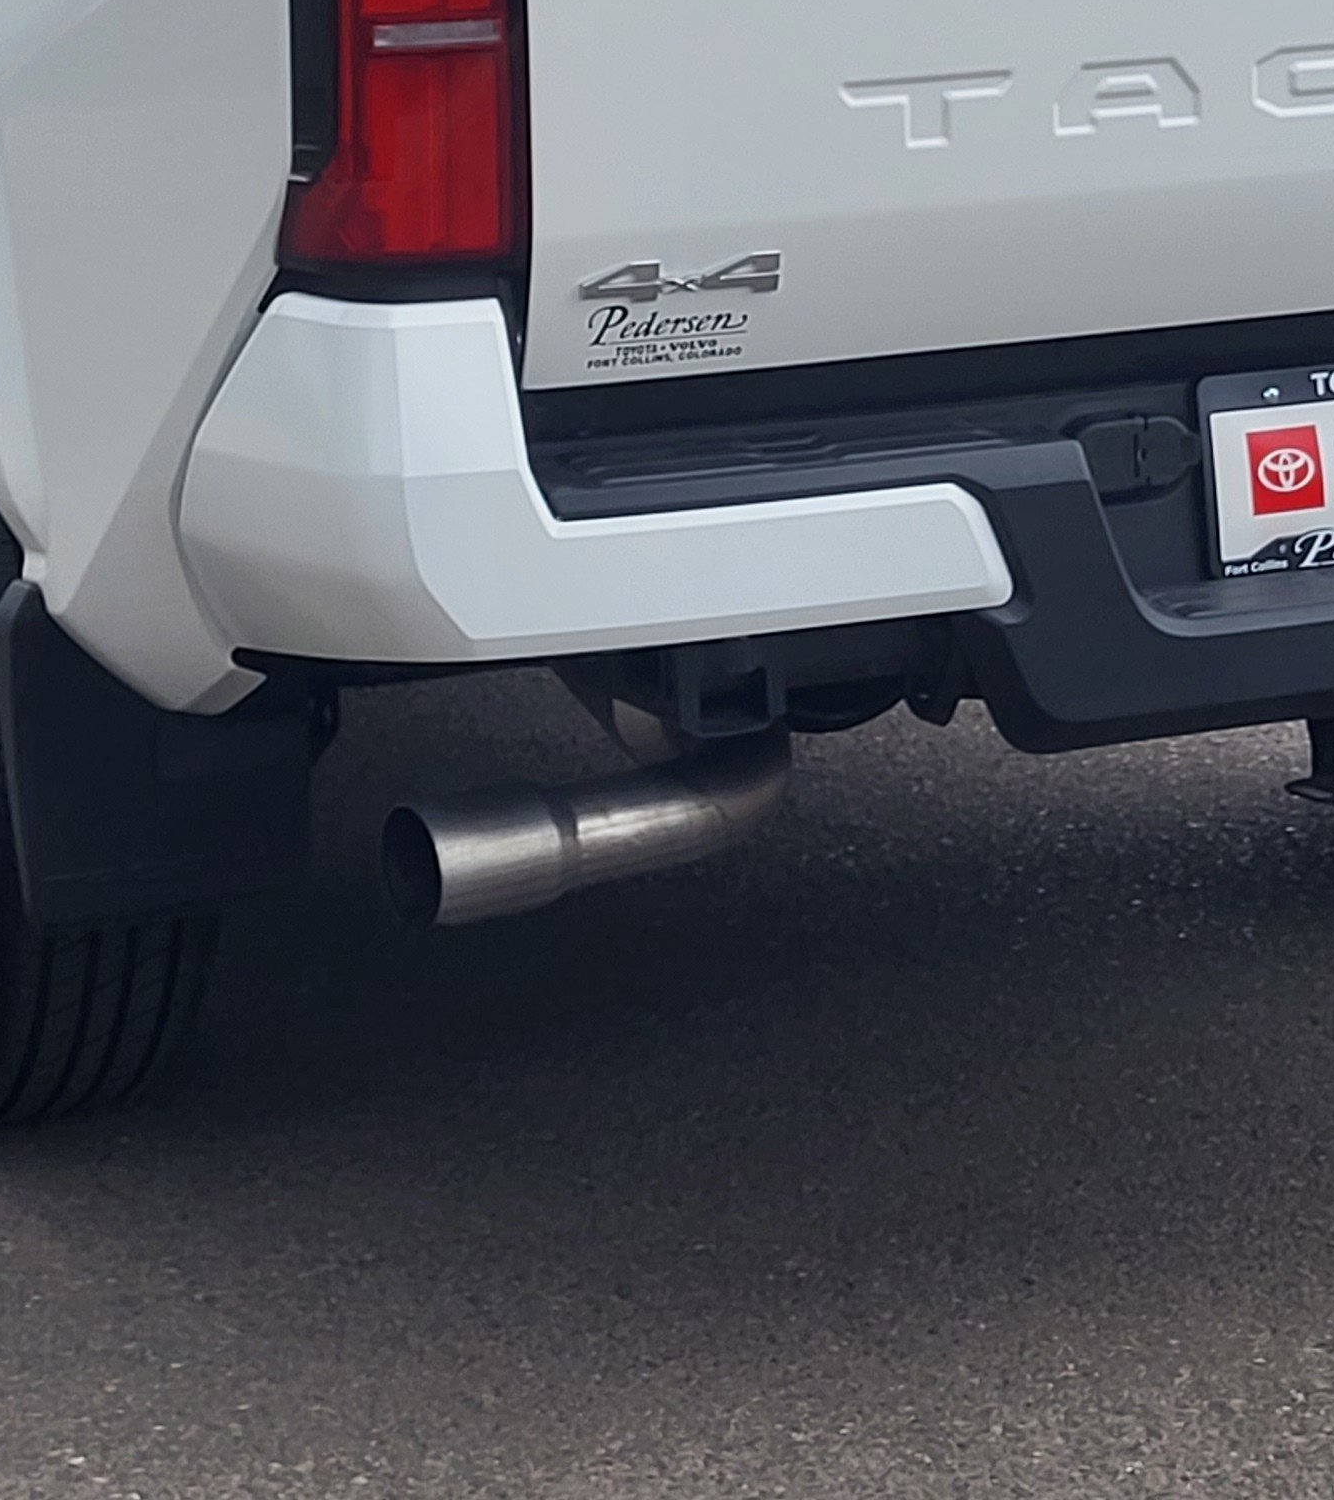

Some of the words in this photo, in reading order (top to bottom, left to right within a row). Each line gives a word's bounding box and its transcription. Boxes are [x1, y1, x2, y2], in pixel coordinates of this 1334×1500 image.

[587, 305, 749, 347] Pedersen
[616, 344, 658, 356] TOYOTA
[669, 338, 718, 351] VOLVO
[587, 358, 617, 369] FORT
[678, 346, 743, 361] COLORADO
[1224, 563, 1248, 577] Fort
